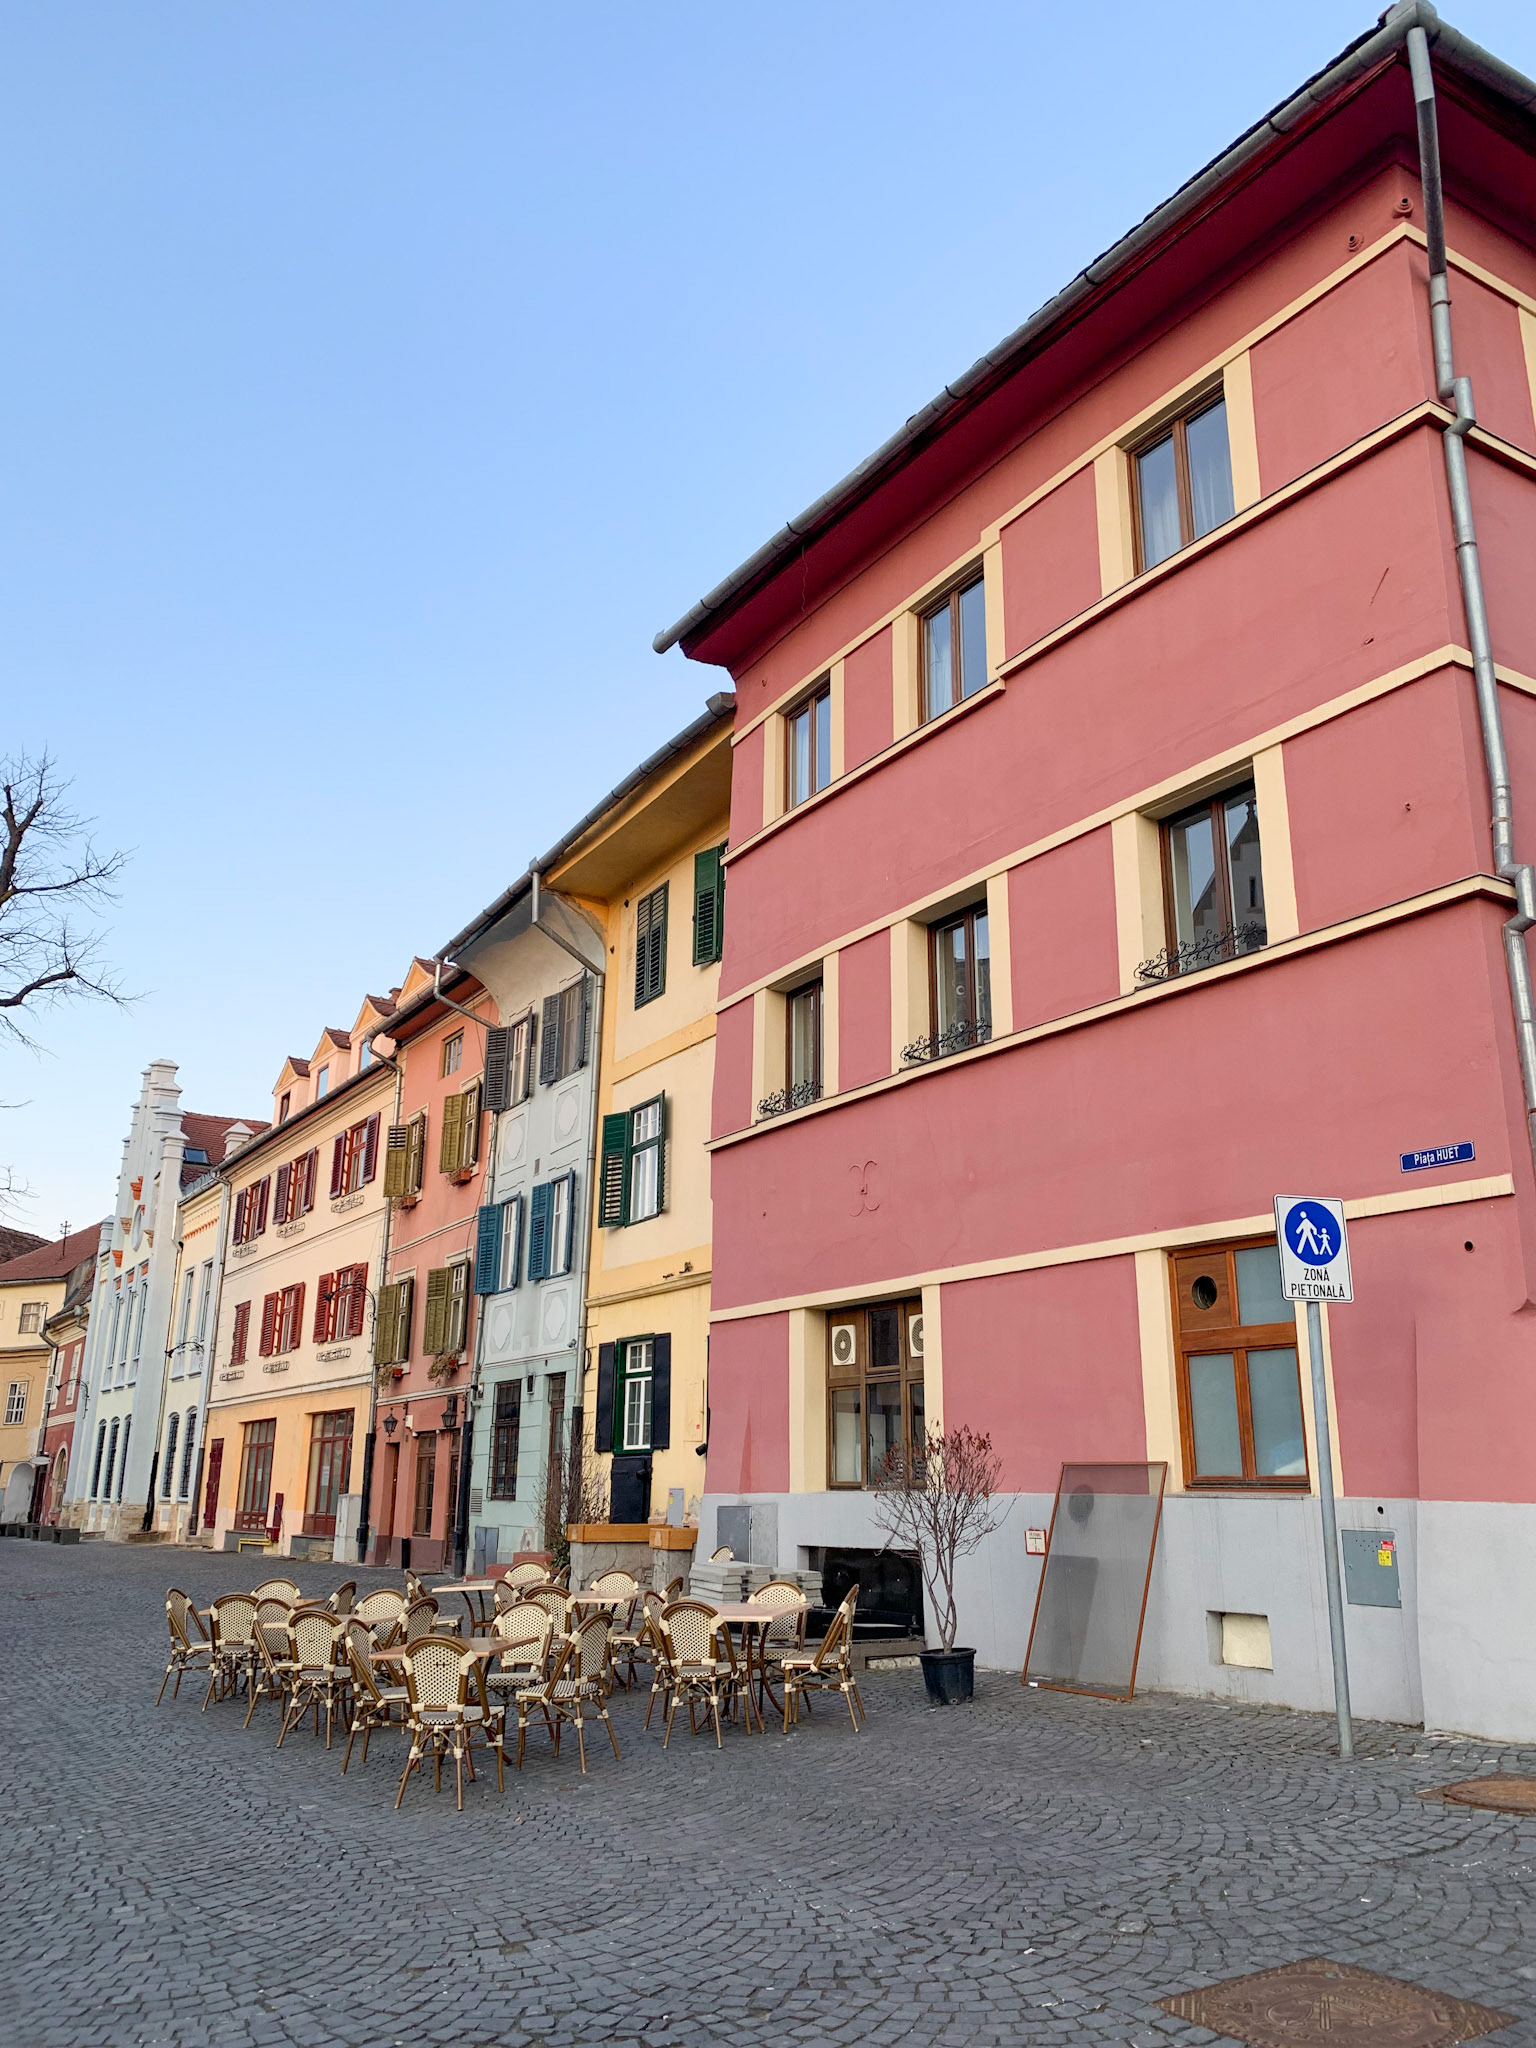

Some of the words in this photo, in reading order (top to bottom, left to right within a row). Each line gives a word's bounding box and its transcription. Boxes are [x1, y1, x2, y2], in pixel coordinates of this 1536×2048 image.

[1436, 1146, 1459, 1161] HUET
[1304, 1267, 1330, 1281] ZONĂ
[1291, 1283, 1345, 1298] PIETONALĂ
